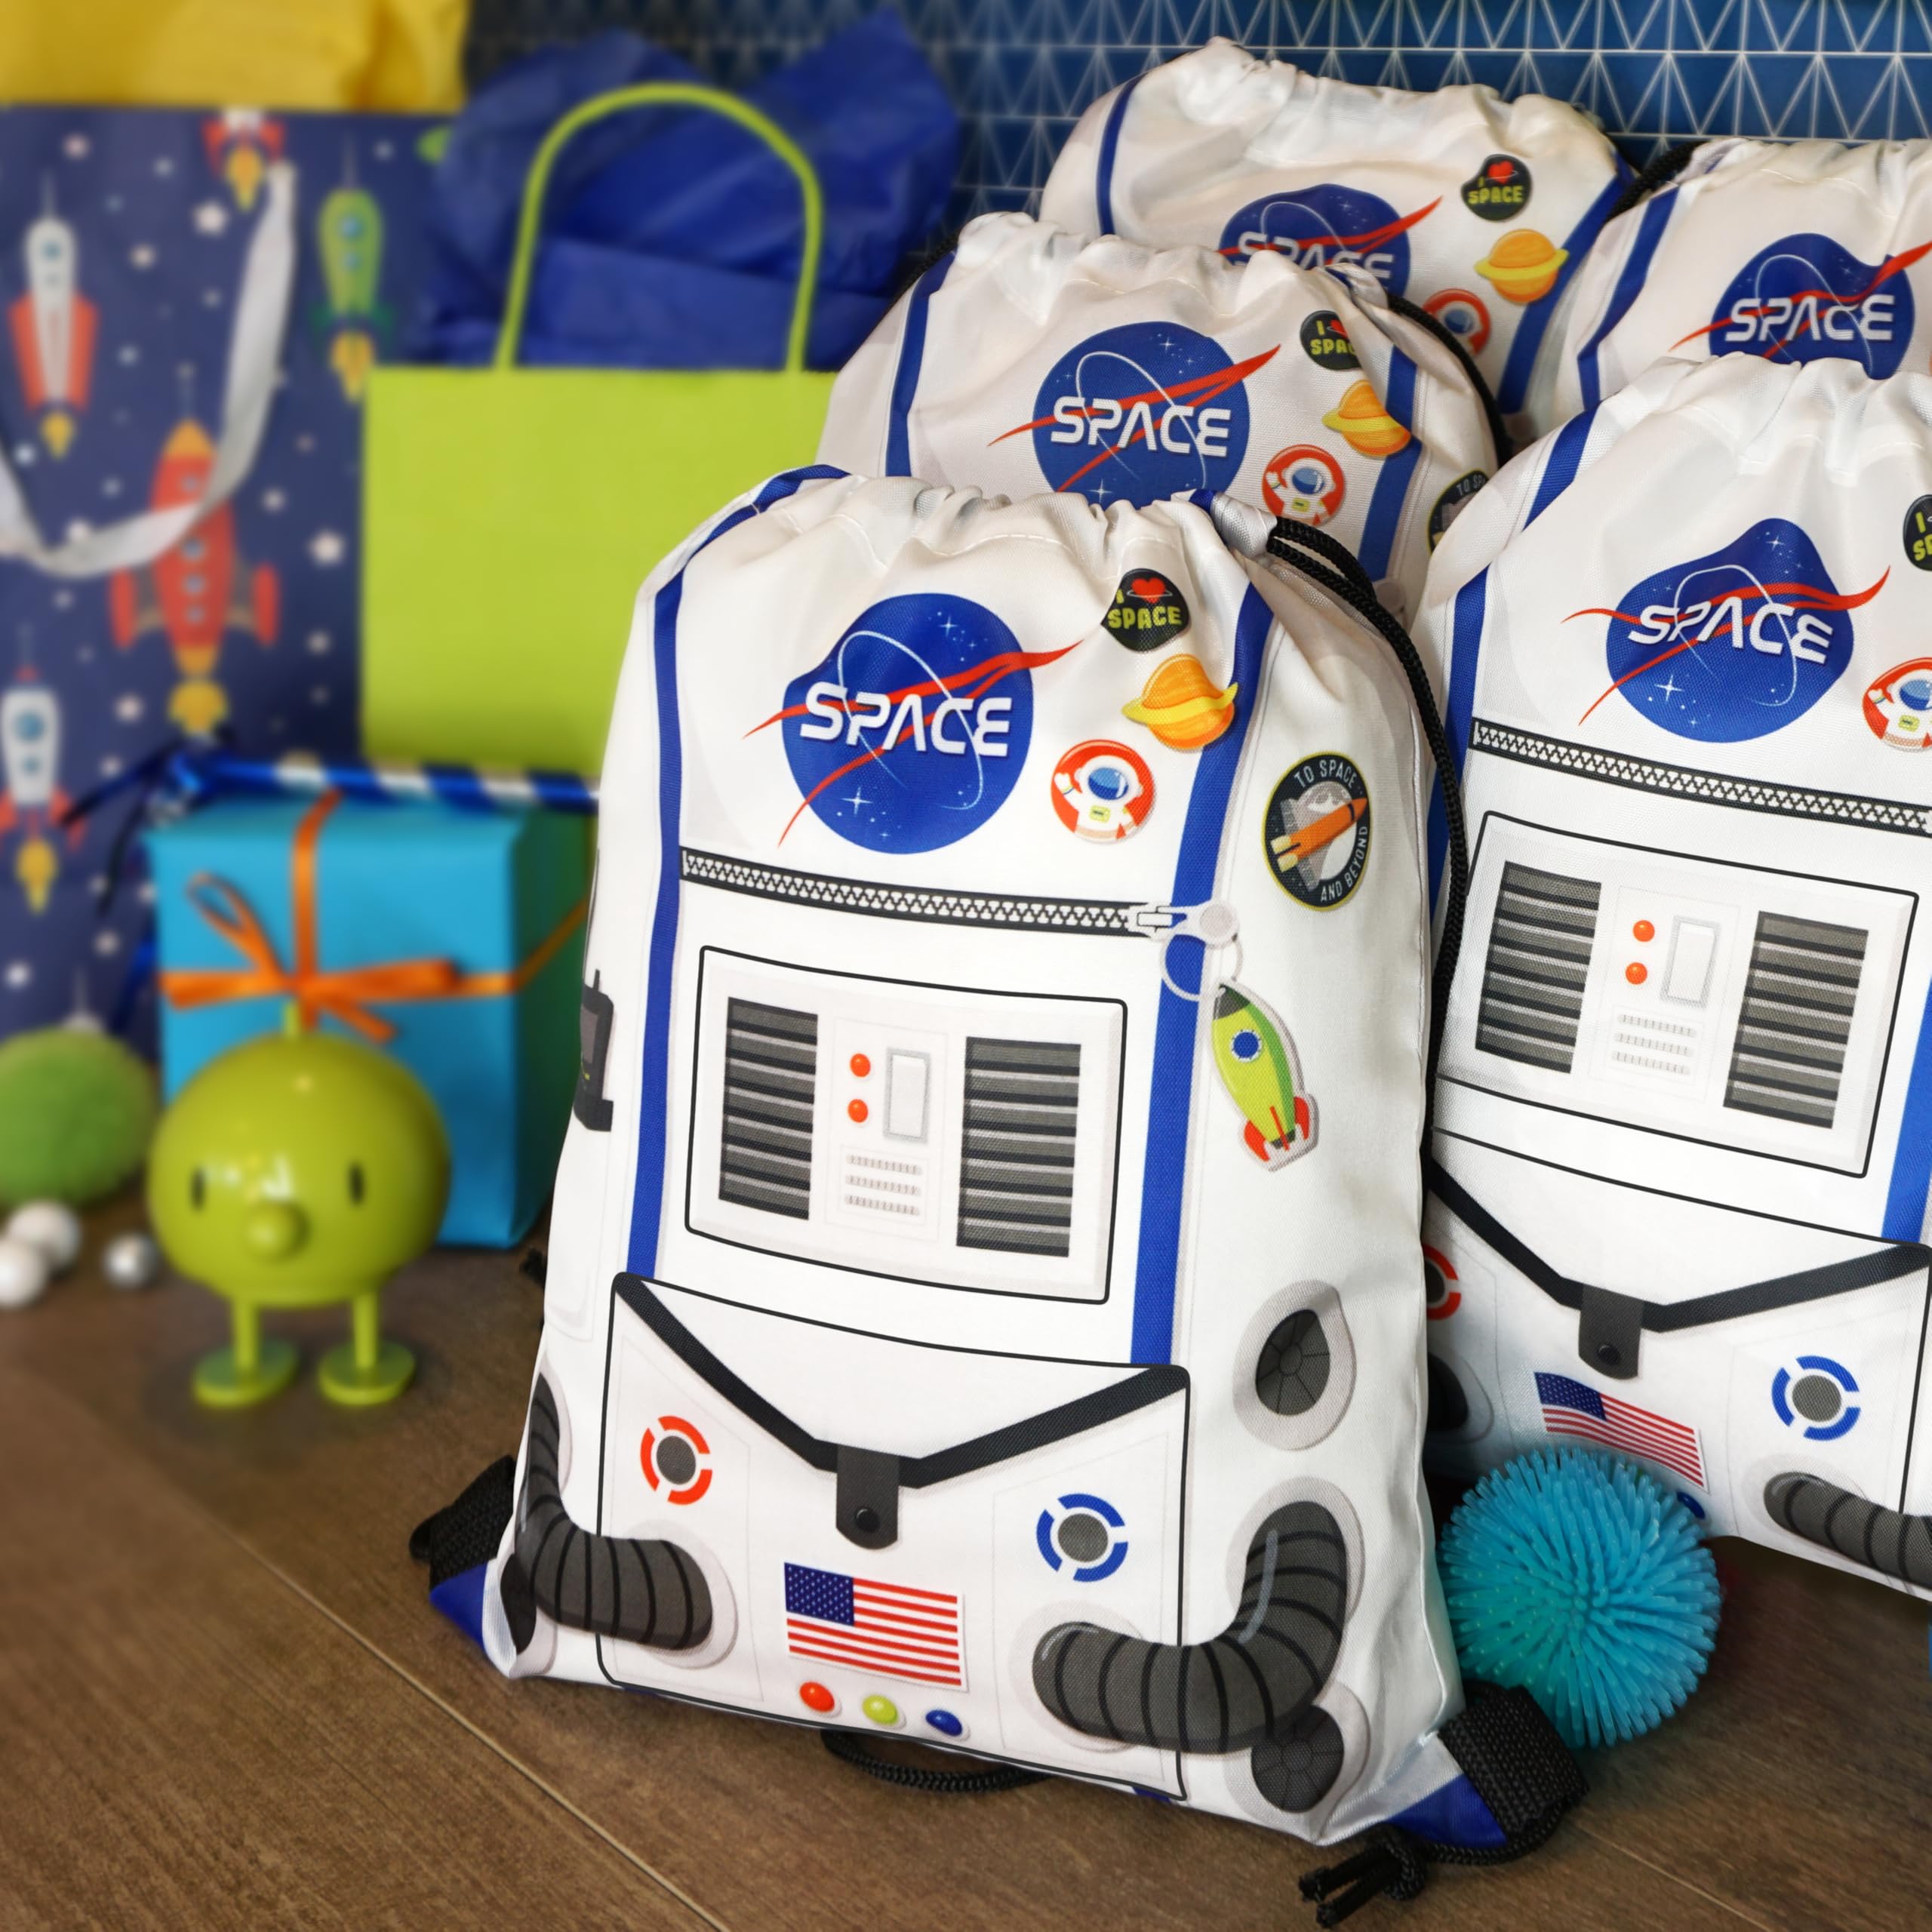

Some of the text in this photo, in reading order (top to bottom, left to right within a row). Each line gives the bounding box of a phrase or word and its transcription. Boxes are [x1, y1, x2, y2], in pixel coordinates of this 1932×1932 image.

[1468, 186, 1523, 205] SPACE
[1315, 320, 1325, 336] I
[1725, 295, 1895, 342] SPACE
[1050, 396, 1232, 457] SPACE
[1456, 478, 1470, 497] TO
[1915, 512, 1927, 534] I
[1107, 605, 1183, 629] SPACE
[1627, 595, 1835, 665] SPACE
[800, 681, 1013, 758] SPACE
[1294, 758, 1358, 789] TO SPACE
[1320, 826, 1368, 903] AND BEYOND
